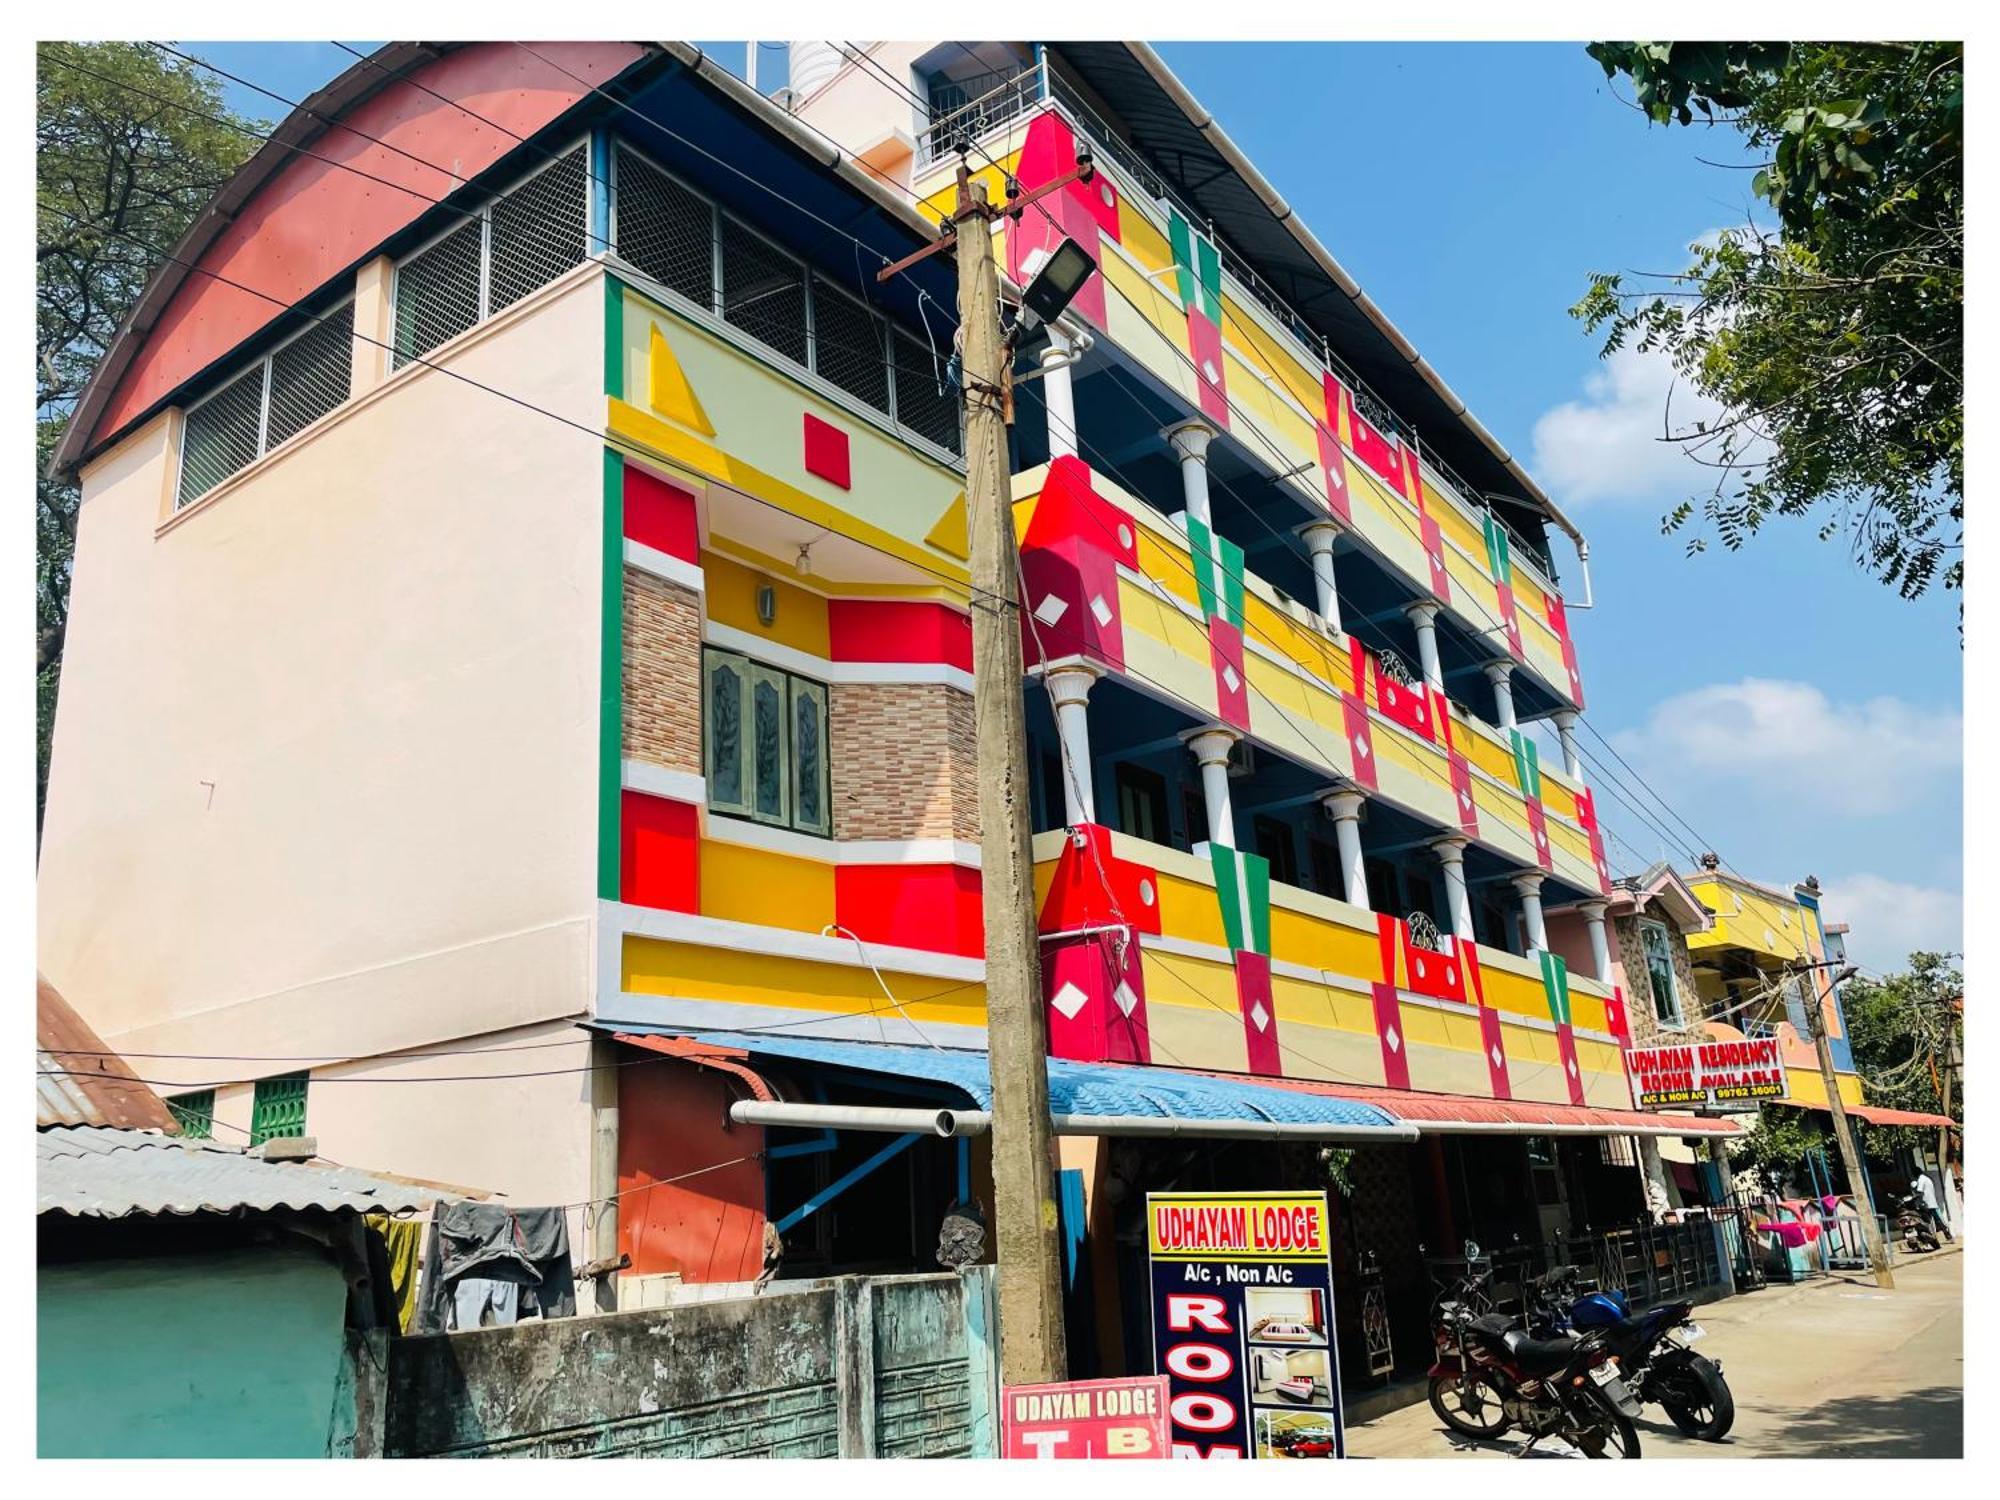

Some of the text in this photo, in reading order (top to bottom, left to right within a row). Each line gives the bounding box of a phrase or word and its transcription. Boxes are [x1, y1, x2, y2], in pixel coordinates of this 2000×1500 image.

[1628, 1040, 1778, 1074] UDHAYAM RESIDENCY
[1641, 1069, 1781, 1092] ROOMS AVAILABLE
[1642, 1094, 1657, 1104] A/C
[1659, 1093, 1667, 1103] &
[1669, 1091, 1690, 1101] NON
[1691, 1090, 1706, 1100] A/C
[1156, 1206, 1320, 1249] UDHAYAM LODGE
[1184, 1263, 1210, 1282] A/c
[1226, 1264, 1260, 1283] Non
[1265, 1264, 1293, 1284] A/c
[1015, 1388, 1157, 1422] UDAYAM LODGE
